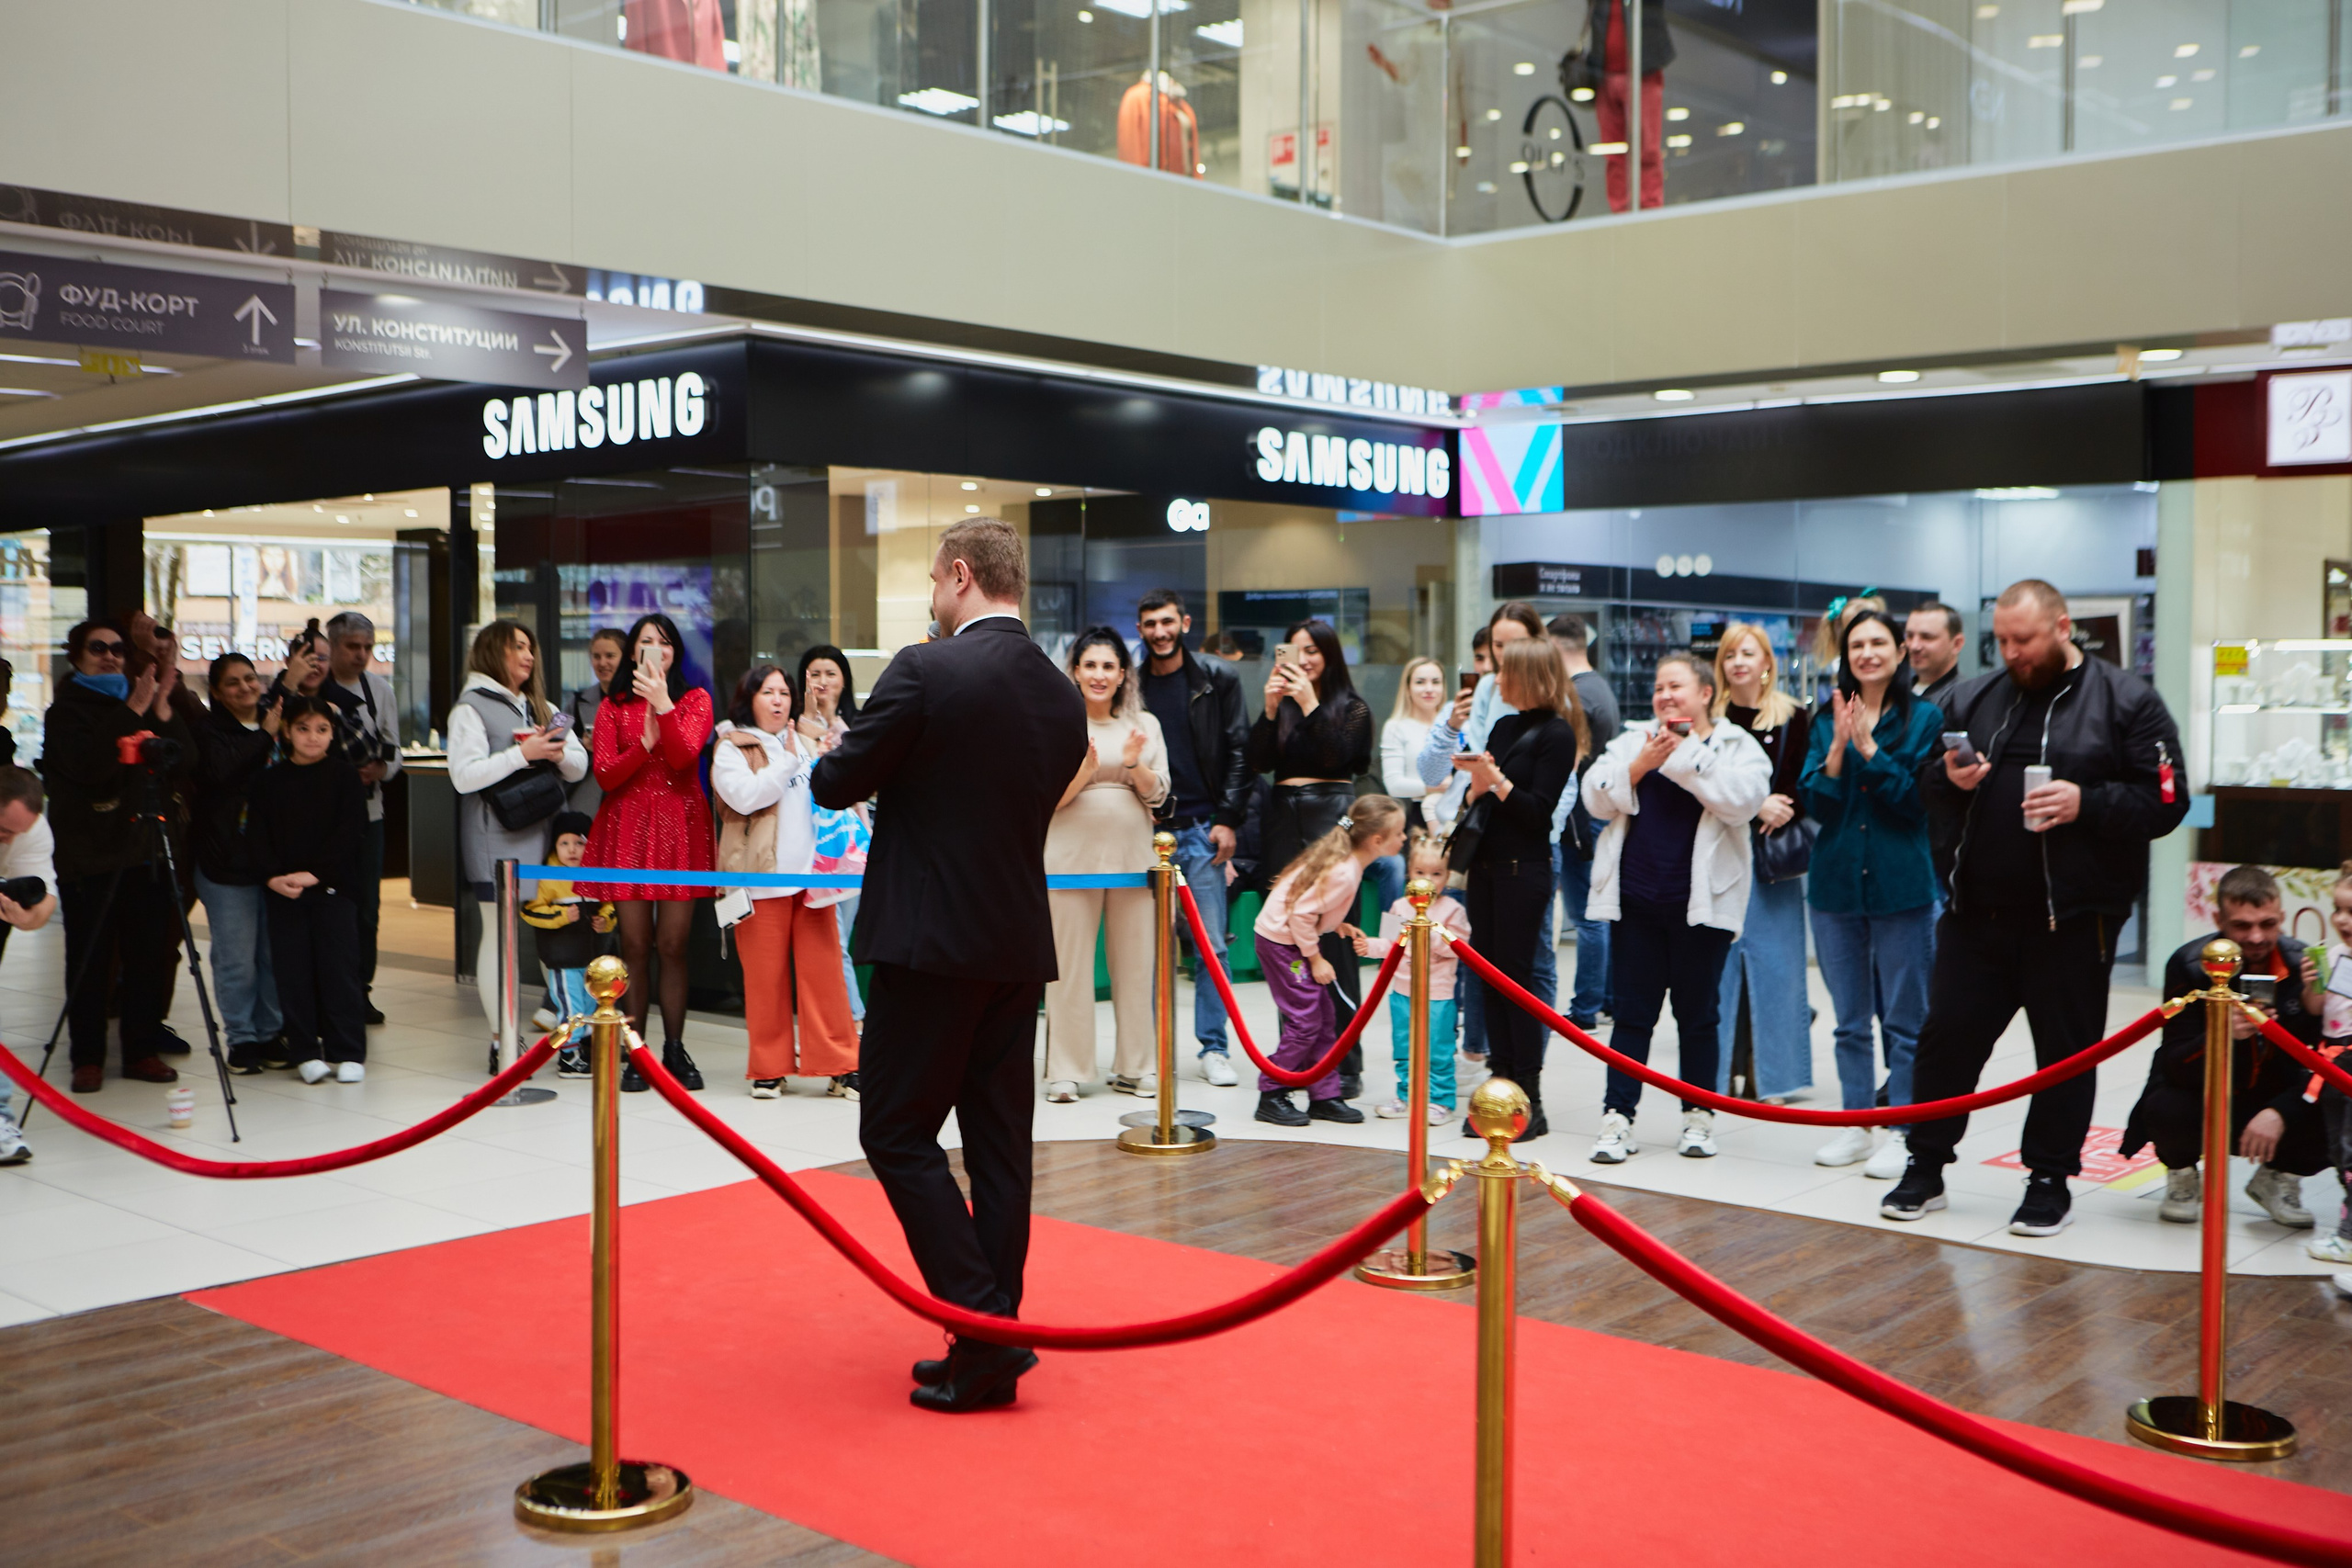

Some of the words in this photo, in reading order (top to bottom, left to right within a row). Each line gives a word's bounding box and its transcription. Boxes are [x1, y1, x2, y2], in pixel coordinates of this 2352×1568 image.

[59, 283, 199, 318] ФУД-КОРТ
[59, 310, 109, 331] FOOD
[110, 316, 165, 336] COURT
[333, 313, 367, 336] УЛ.
[371, 318, 519, 353] КОНСТИТУЦИИ
[482, 371, 705, 459] SAMSUNG
[1257, 426, 1450, 499] SAMSUNG
